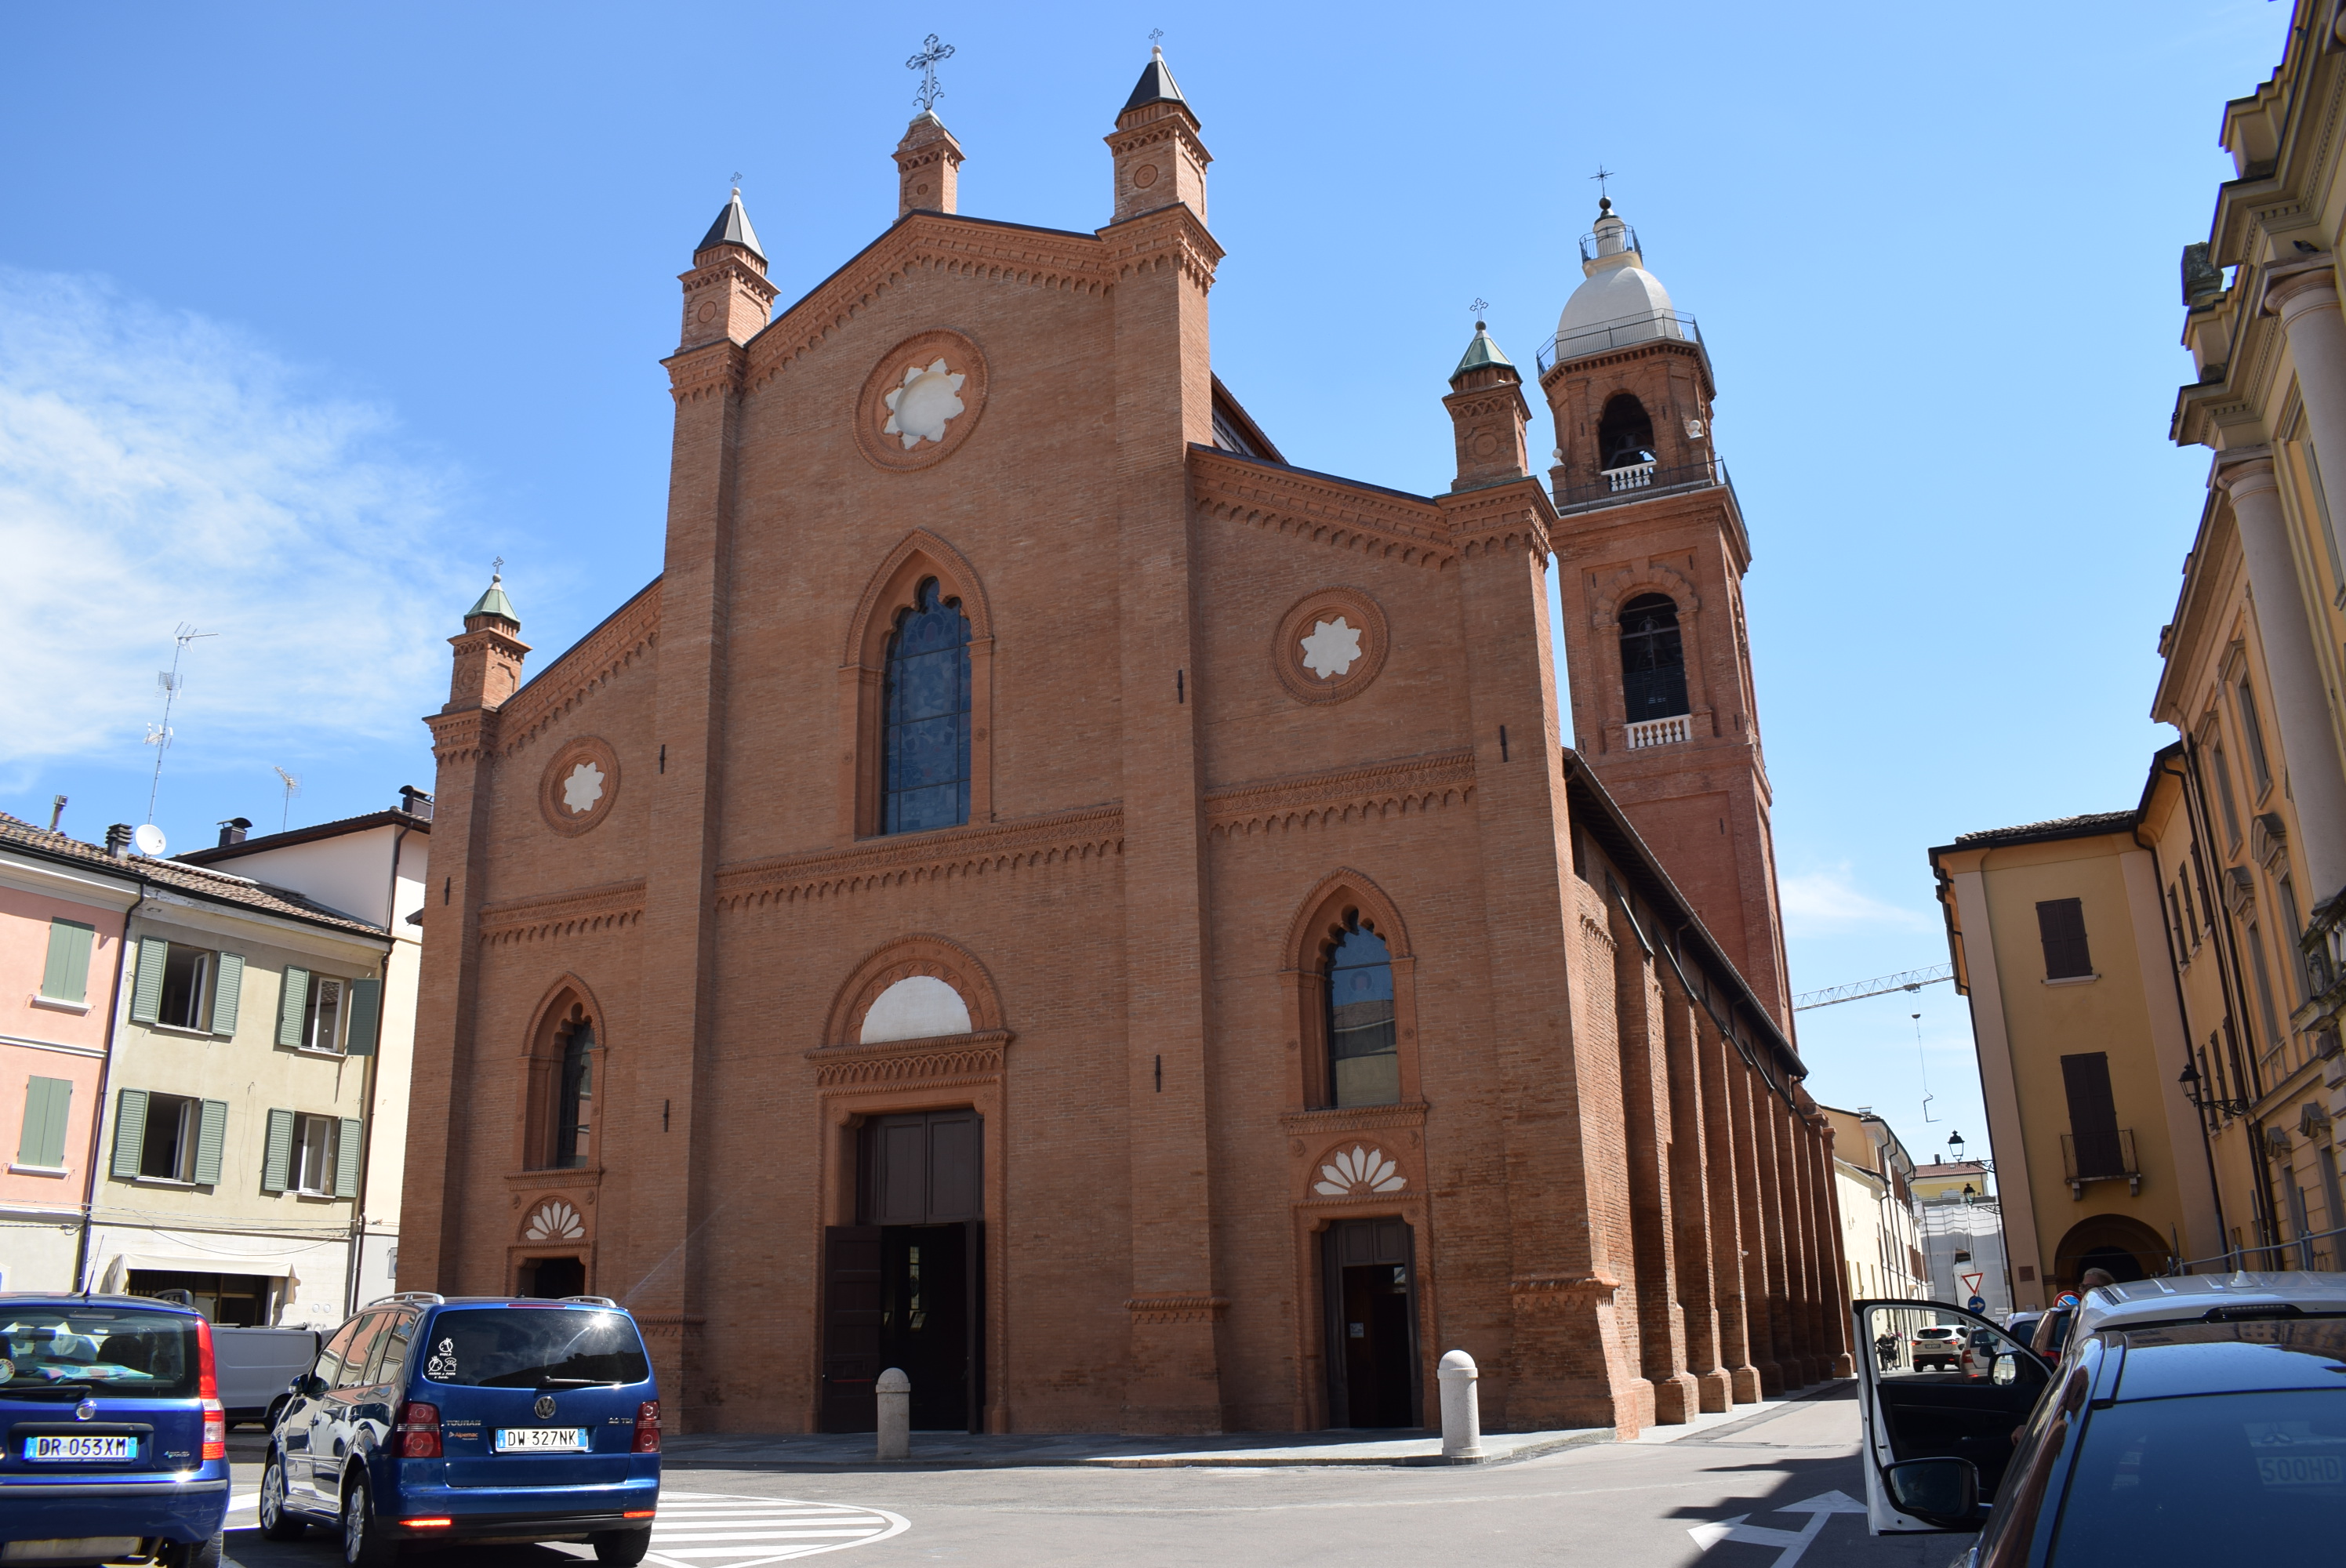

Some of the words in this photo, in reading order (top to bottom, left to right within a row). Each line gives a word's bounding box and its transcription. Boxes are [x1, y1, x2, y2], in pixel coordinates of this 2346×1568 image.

[39, 1439, 61, 1456] DR
[70, 1438, 126, 1456] 053XM
[508, 1432, 525, 1446] DW
[532, 1431, 576, 1446] 327NK
[2261, 1457, 2340, 1483] 500HD
